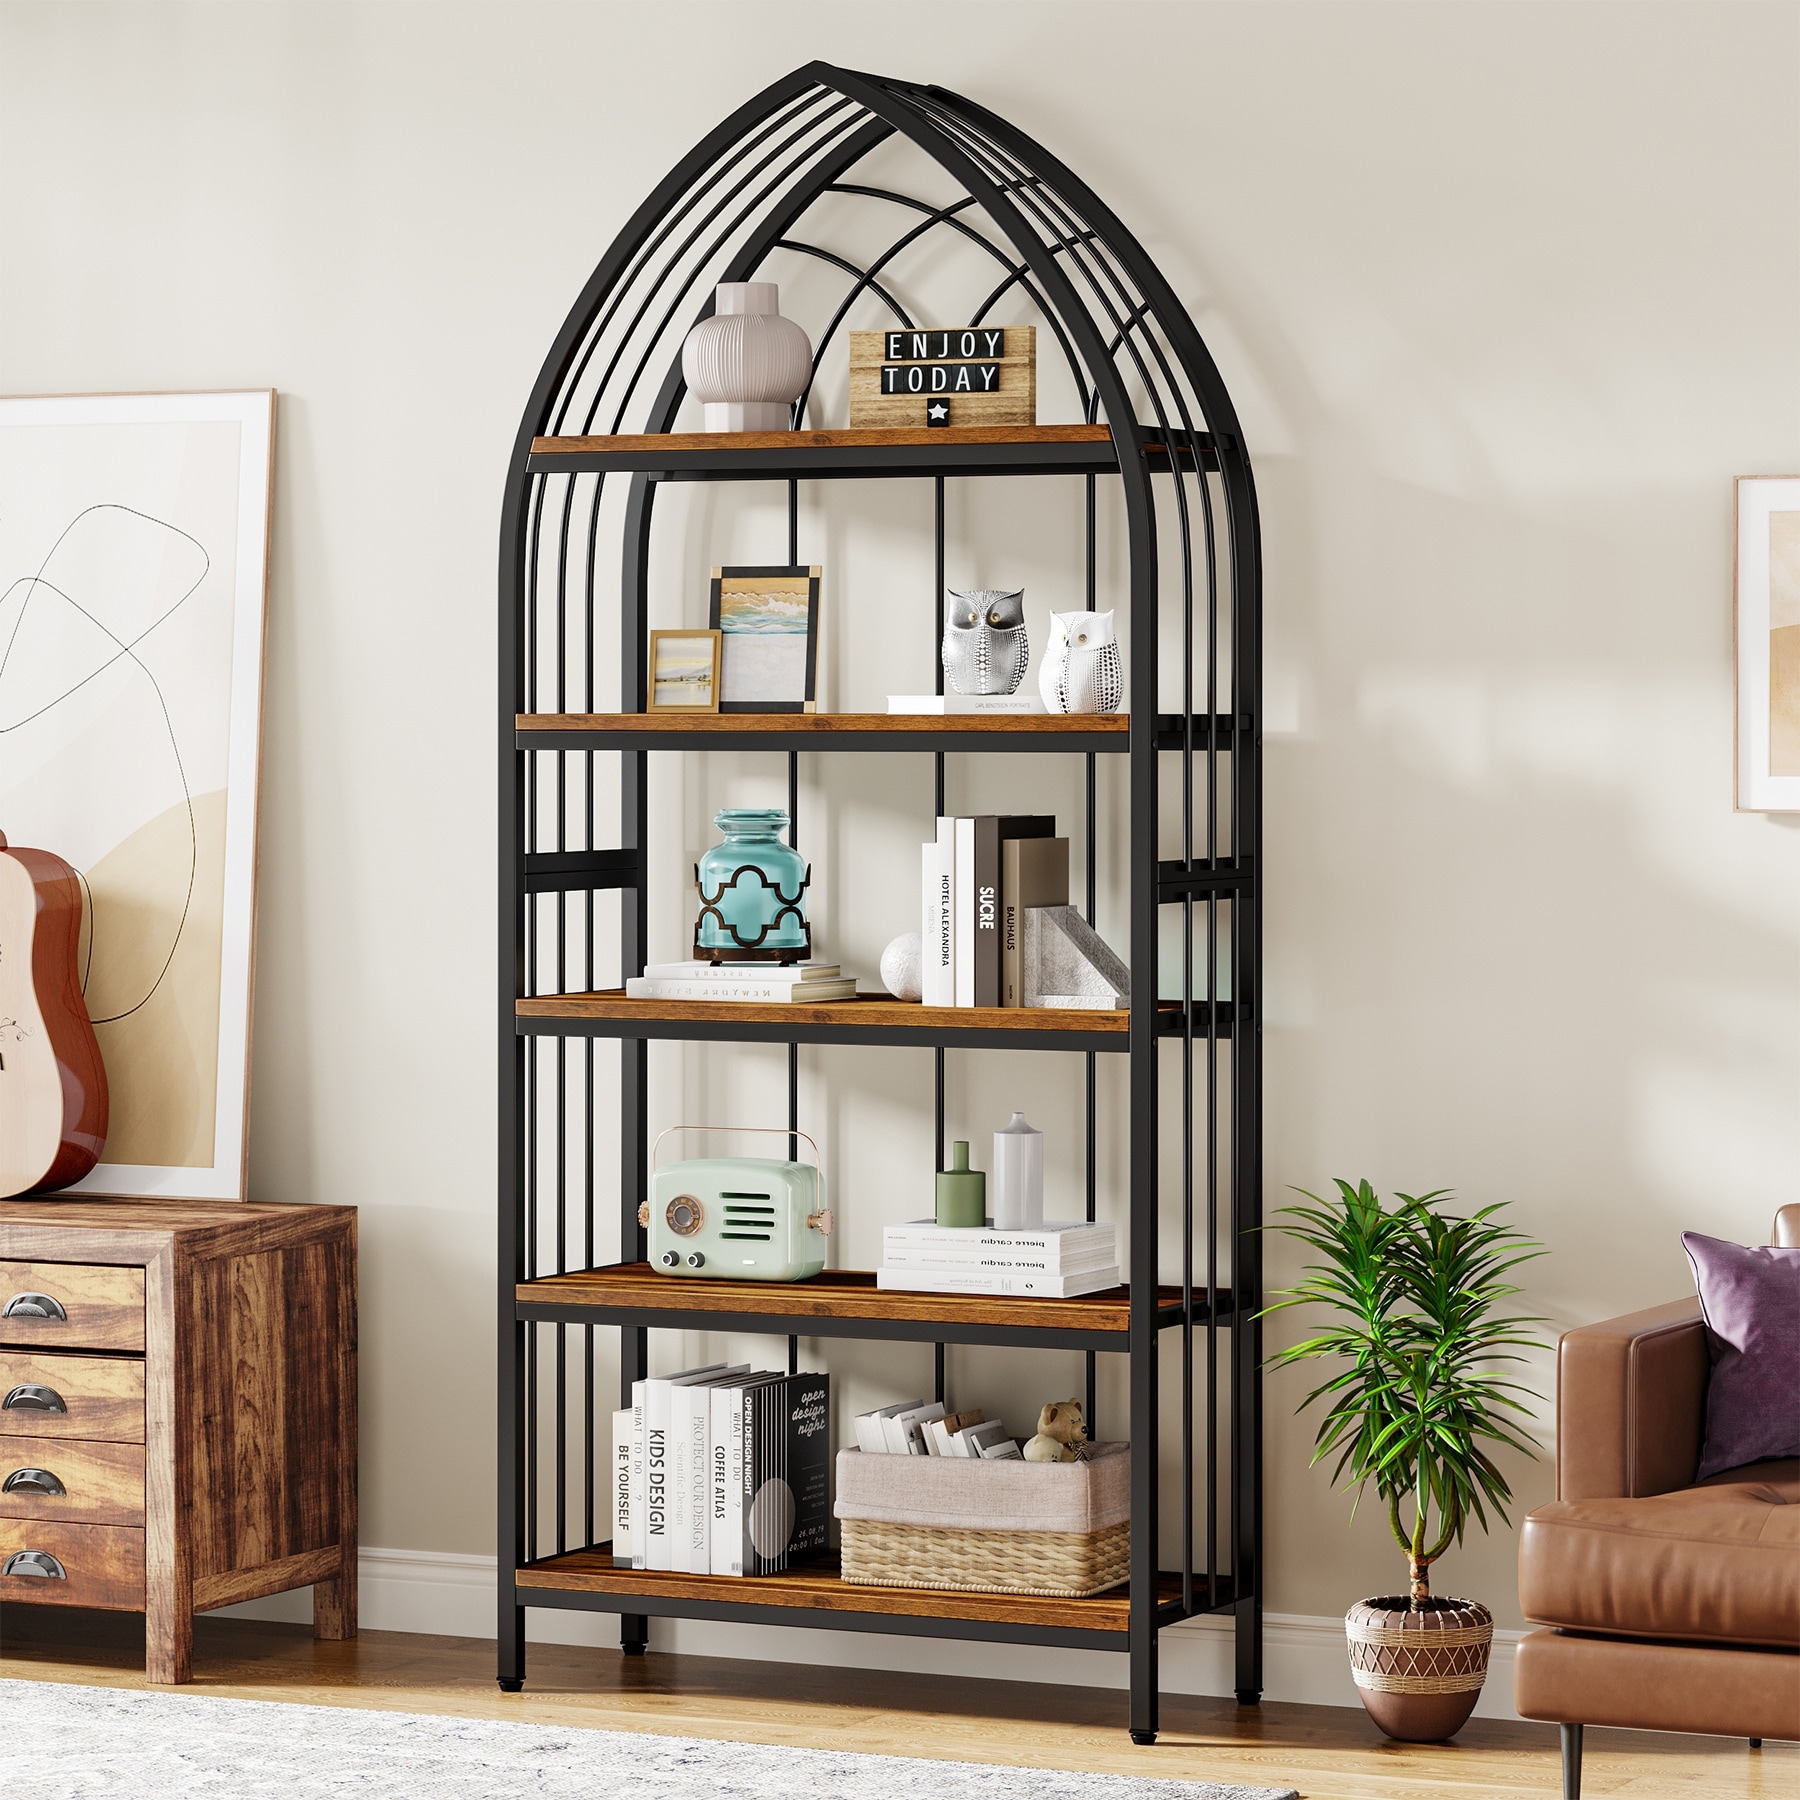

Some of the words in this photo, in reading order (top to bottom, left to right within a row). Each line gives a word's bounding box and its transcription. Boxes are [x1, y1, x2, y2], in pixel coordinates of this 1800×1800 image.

[889, 332, 1000, 359] ENJOY
[884, 366, 996, 392] TODAY
[979, 886, 994, 929] SUCRE
[792, 1404, 825, 1421] design
[801, 1390, 825, 1406] open
[798, 1418, 825, 1437] night
[618, 1445, 629, 1461] BE
[634, 1441, 642, 1454] TO
[650, 1430, 664, 1468] KIDS
[693, 1416, 704, 1472] PROTECT
[733, 1448, 741, 1460] TO
[676, 1442, 686, 1487] Scientific
[715, 1446, 725, 1483] COFFEE
[618, 1465, 629, 1531] YOURSELF
[693, 1474, 704, 1501] OUR
[715, 1487, 725, 1519] ATLAS
[650, 1473, 664, 1535] DESIGN
[676, 1491, 686, 1525] Design
[693, 1505, 704, 1550] DESIGN
